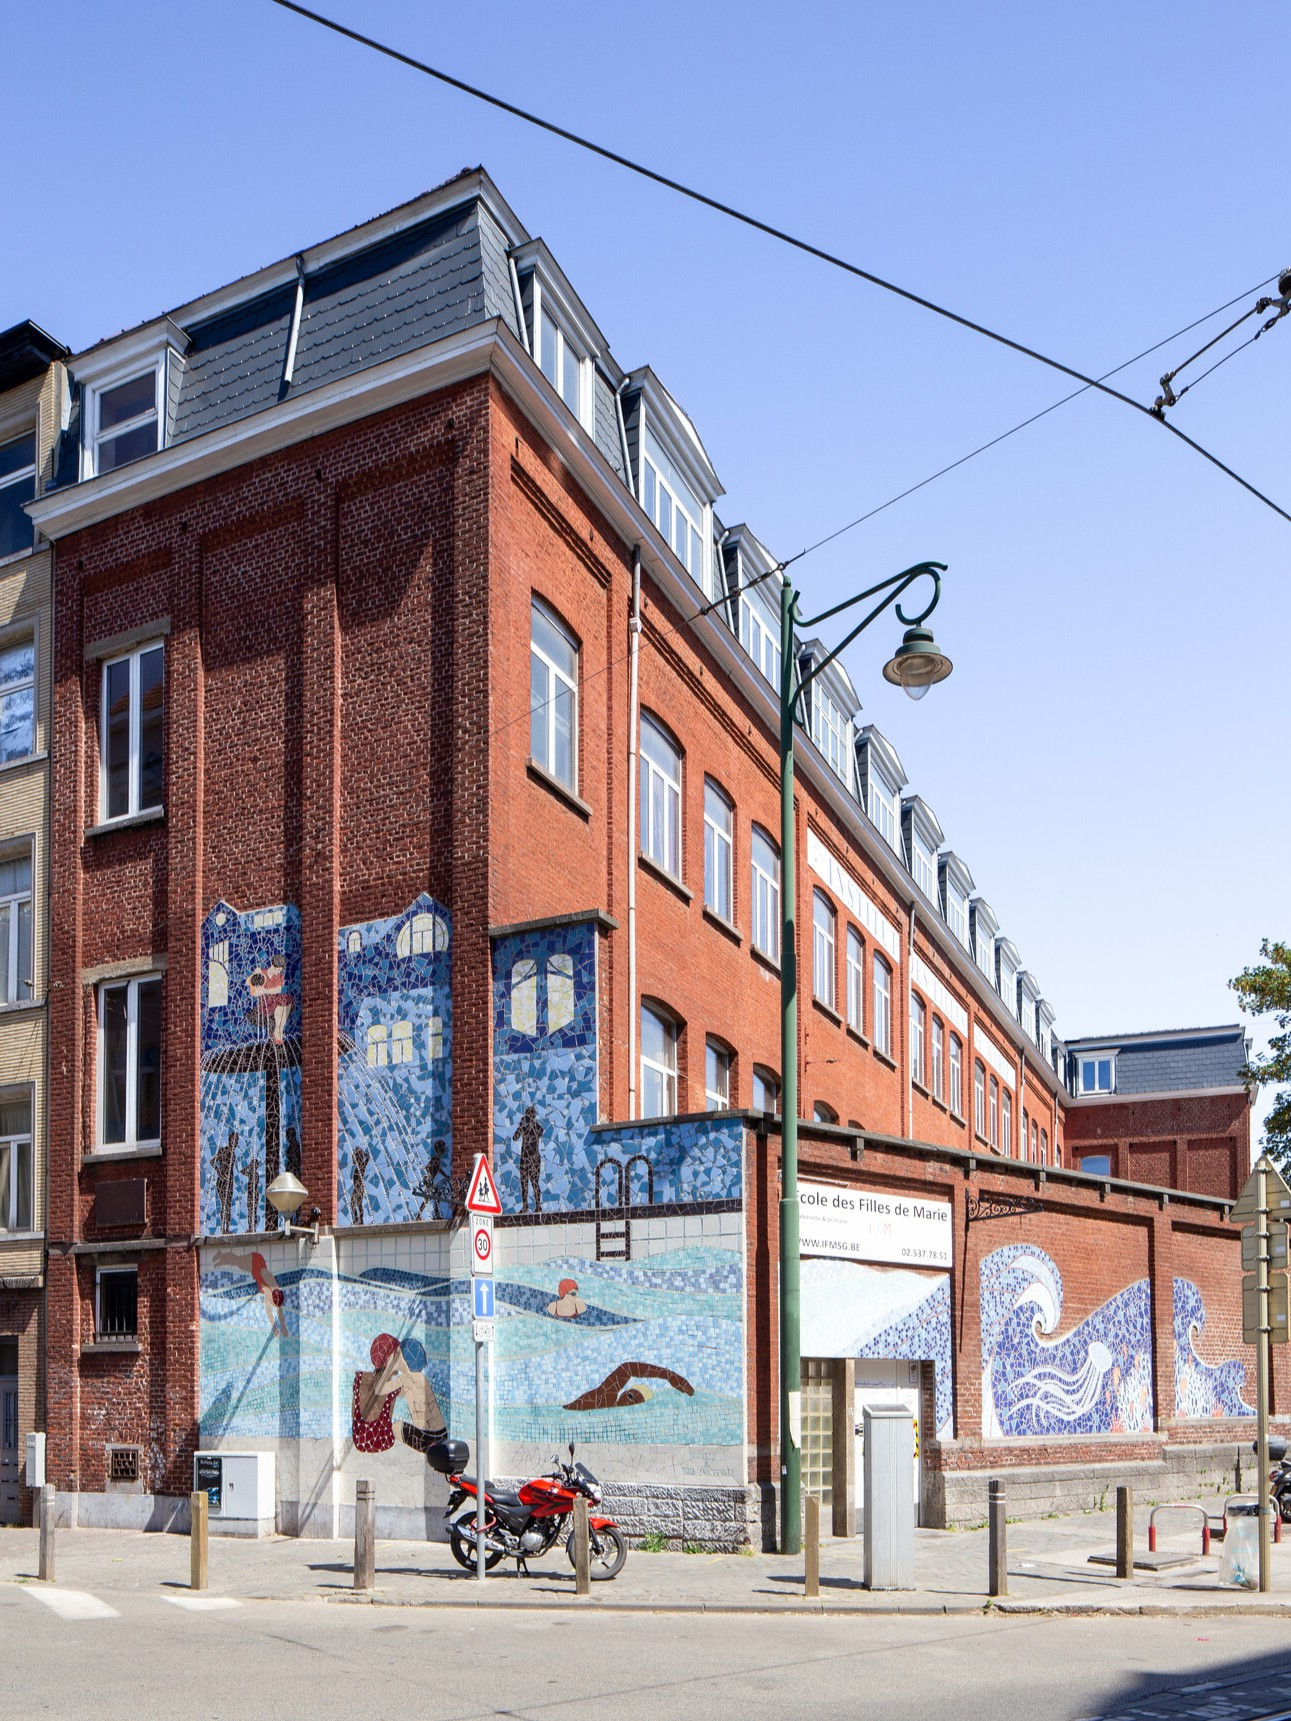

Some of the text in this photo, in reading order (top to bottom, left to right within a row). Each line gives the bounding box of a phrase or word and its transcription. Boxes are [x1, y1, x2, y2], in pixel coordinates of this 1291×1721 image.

[797, 1189, 948, 1222] cole des Filles de Marie
[476, 1217, 489, 1226] ZONE
[478, 1238, 488, 1251] 30
[799, 1238, 860, 1251] WW.IFMSG.BE
[901, 1248, 948, 1261] 02.537.78.51
